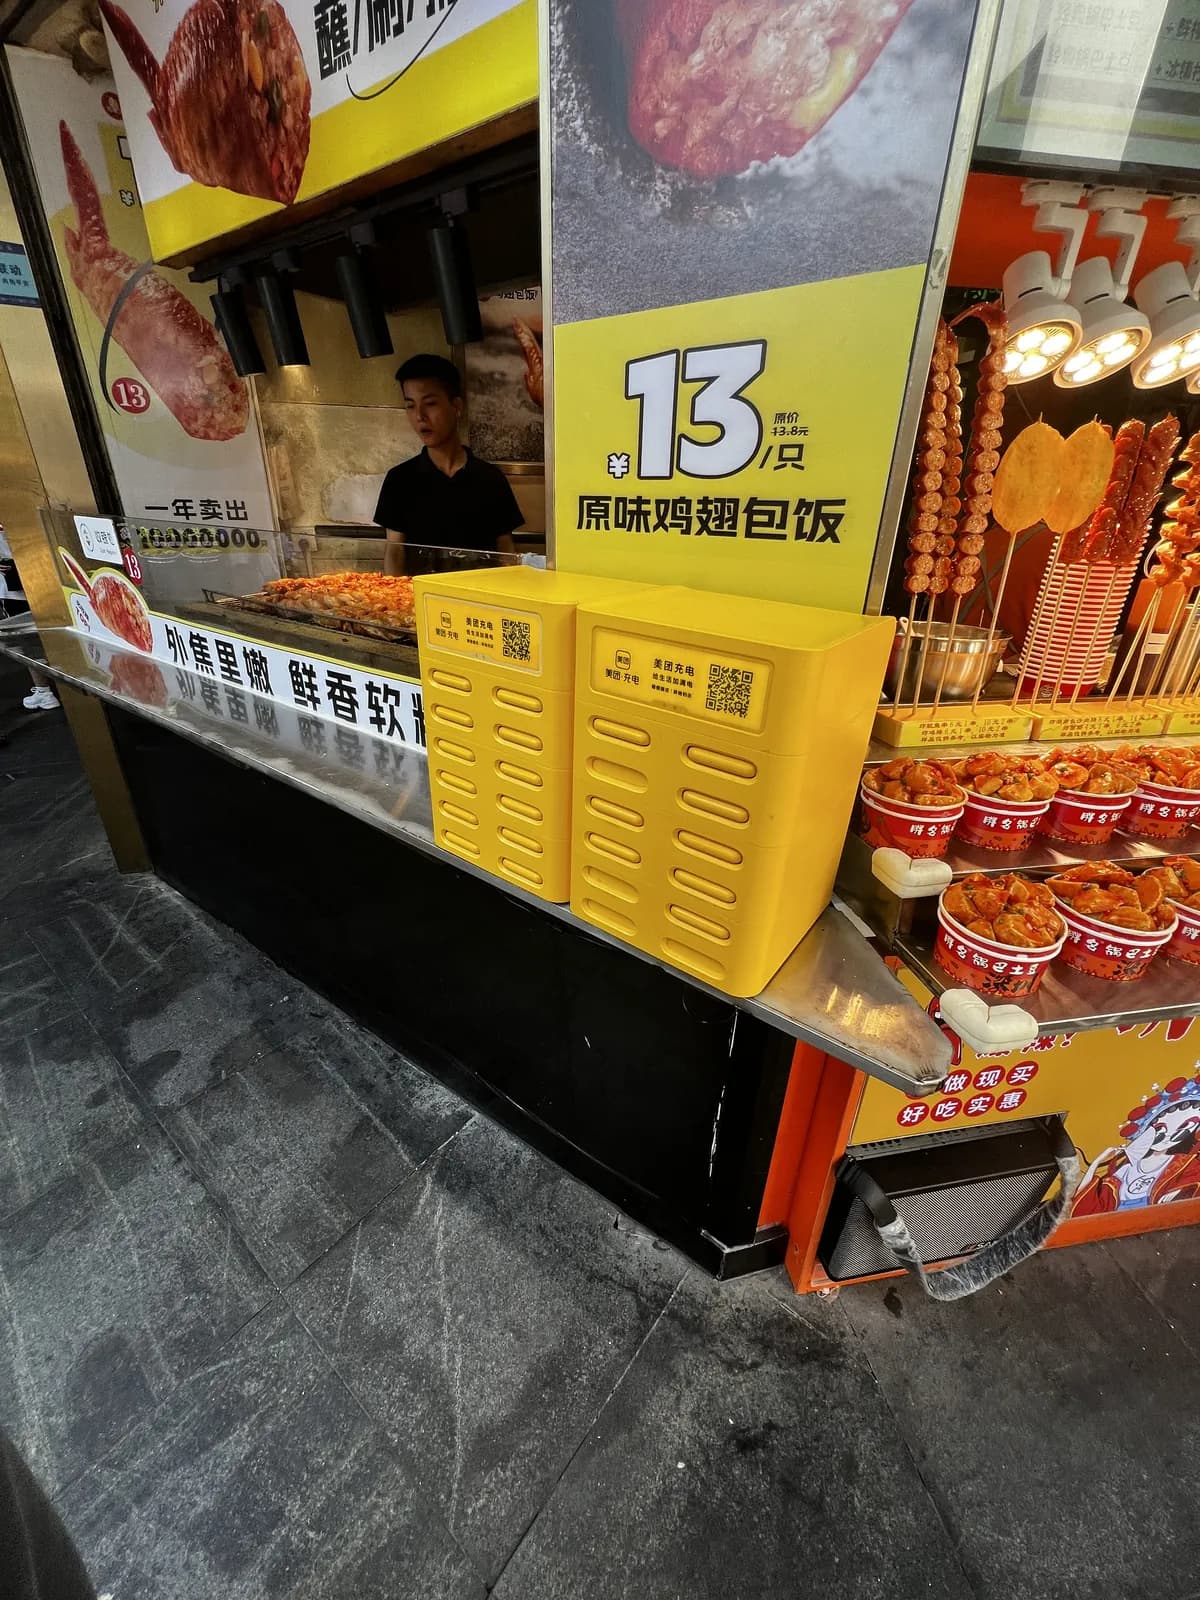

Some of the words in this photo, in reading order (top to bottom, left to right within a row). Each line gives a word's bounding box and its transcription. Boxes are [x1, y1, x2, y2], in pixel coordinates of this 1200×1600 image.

[116, 383, 147, 408] 13
[773, 411, 799, 425] 原价
[144, 498, 249, 521] 一年卖出
[576, 494, 847, 544] 原味鸡翅包饭
[124, 553, 142, 580] 13
[165, 623, 274, 696] 外焦里嫩
[653, 657, 696, 678] 美团充电
[901, 1091, 1022, 1125] 好吃实惠
